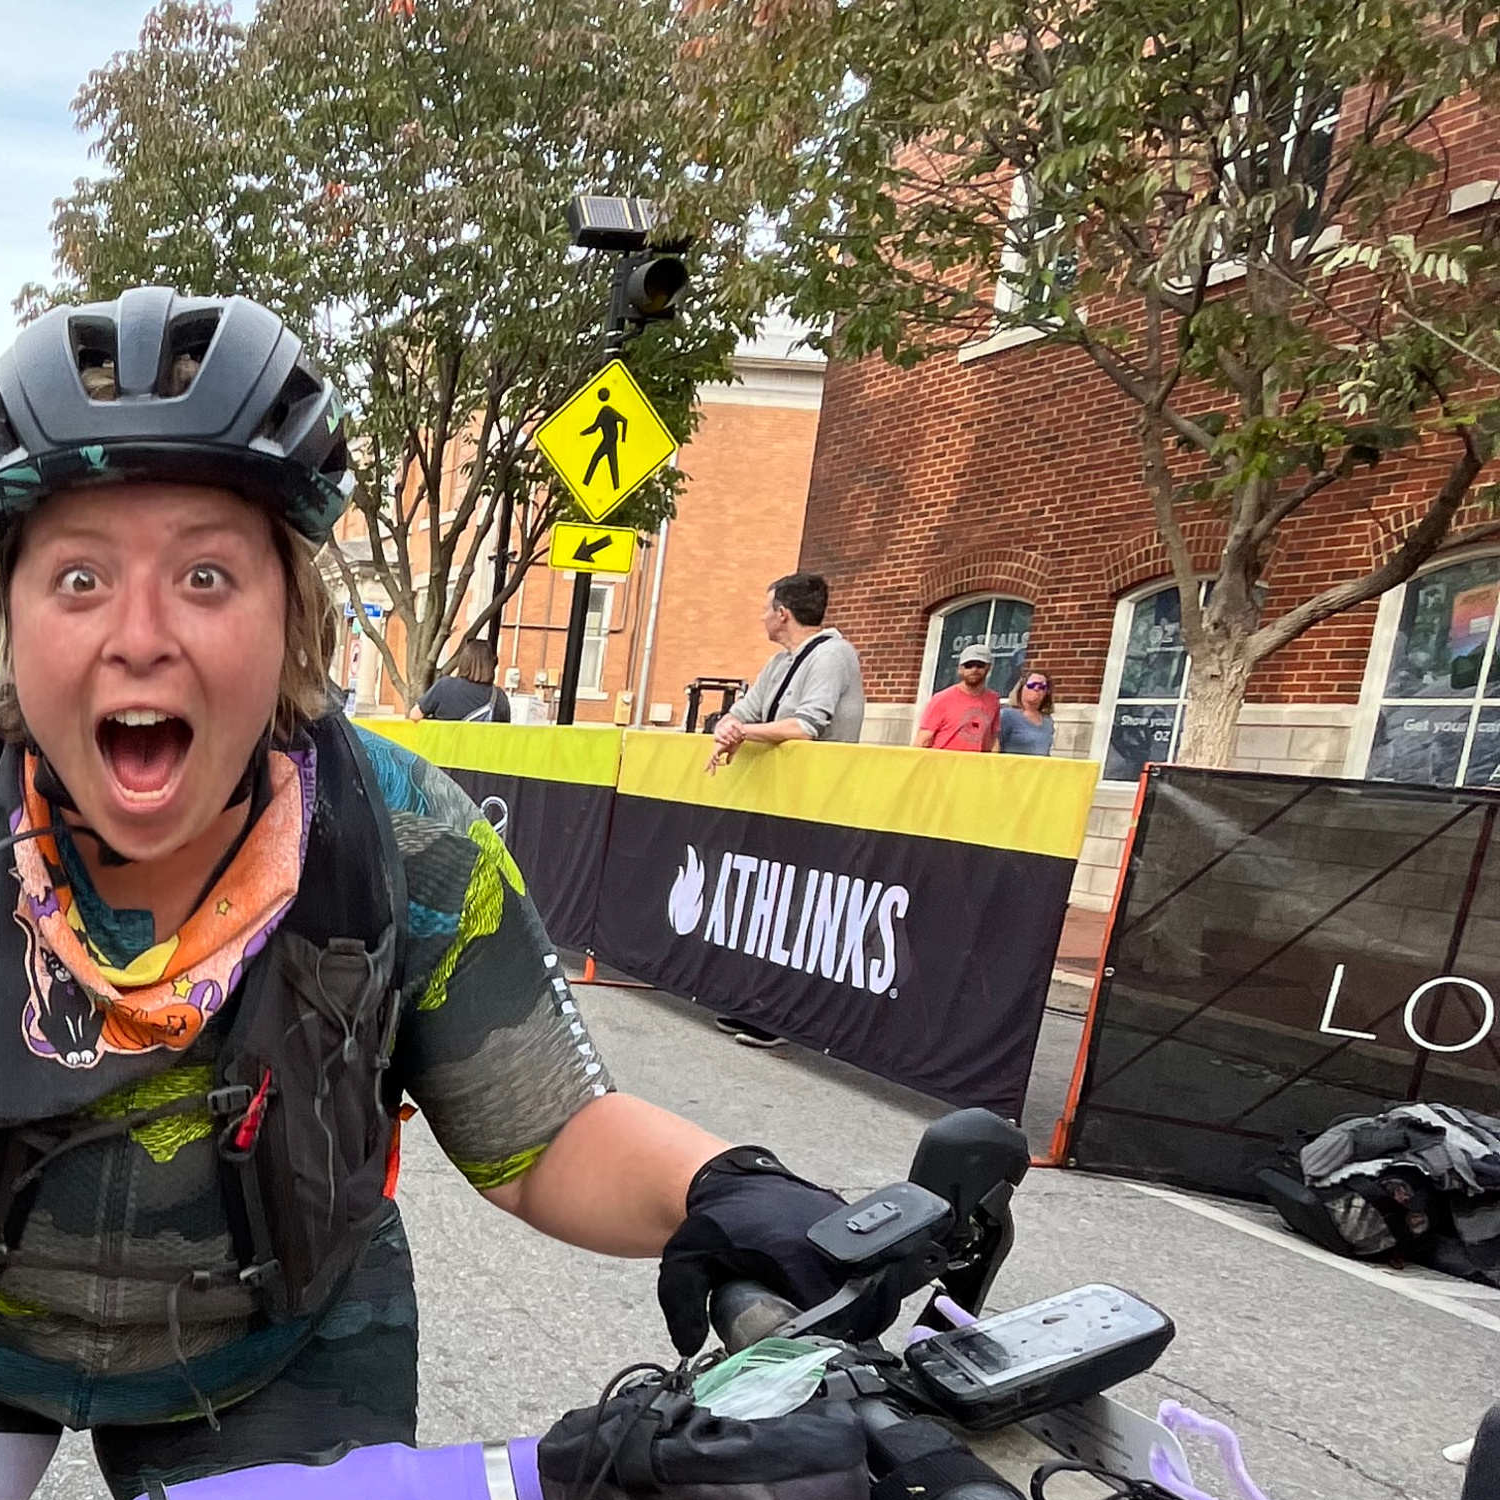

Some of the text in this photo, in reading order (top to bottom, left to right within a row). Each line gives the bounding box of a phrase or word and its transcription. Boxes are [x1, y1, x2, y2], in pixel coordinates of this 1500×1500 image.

[1120, 714, 1149, 727] Show
[1403, 718, 1430, 732] Get
[1153, 730, 1172, 742] OZ
[703, 851, 911, 996] ATHLINKS
